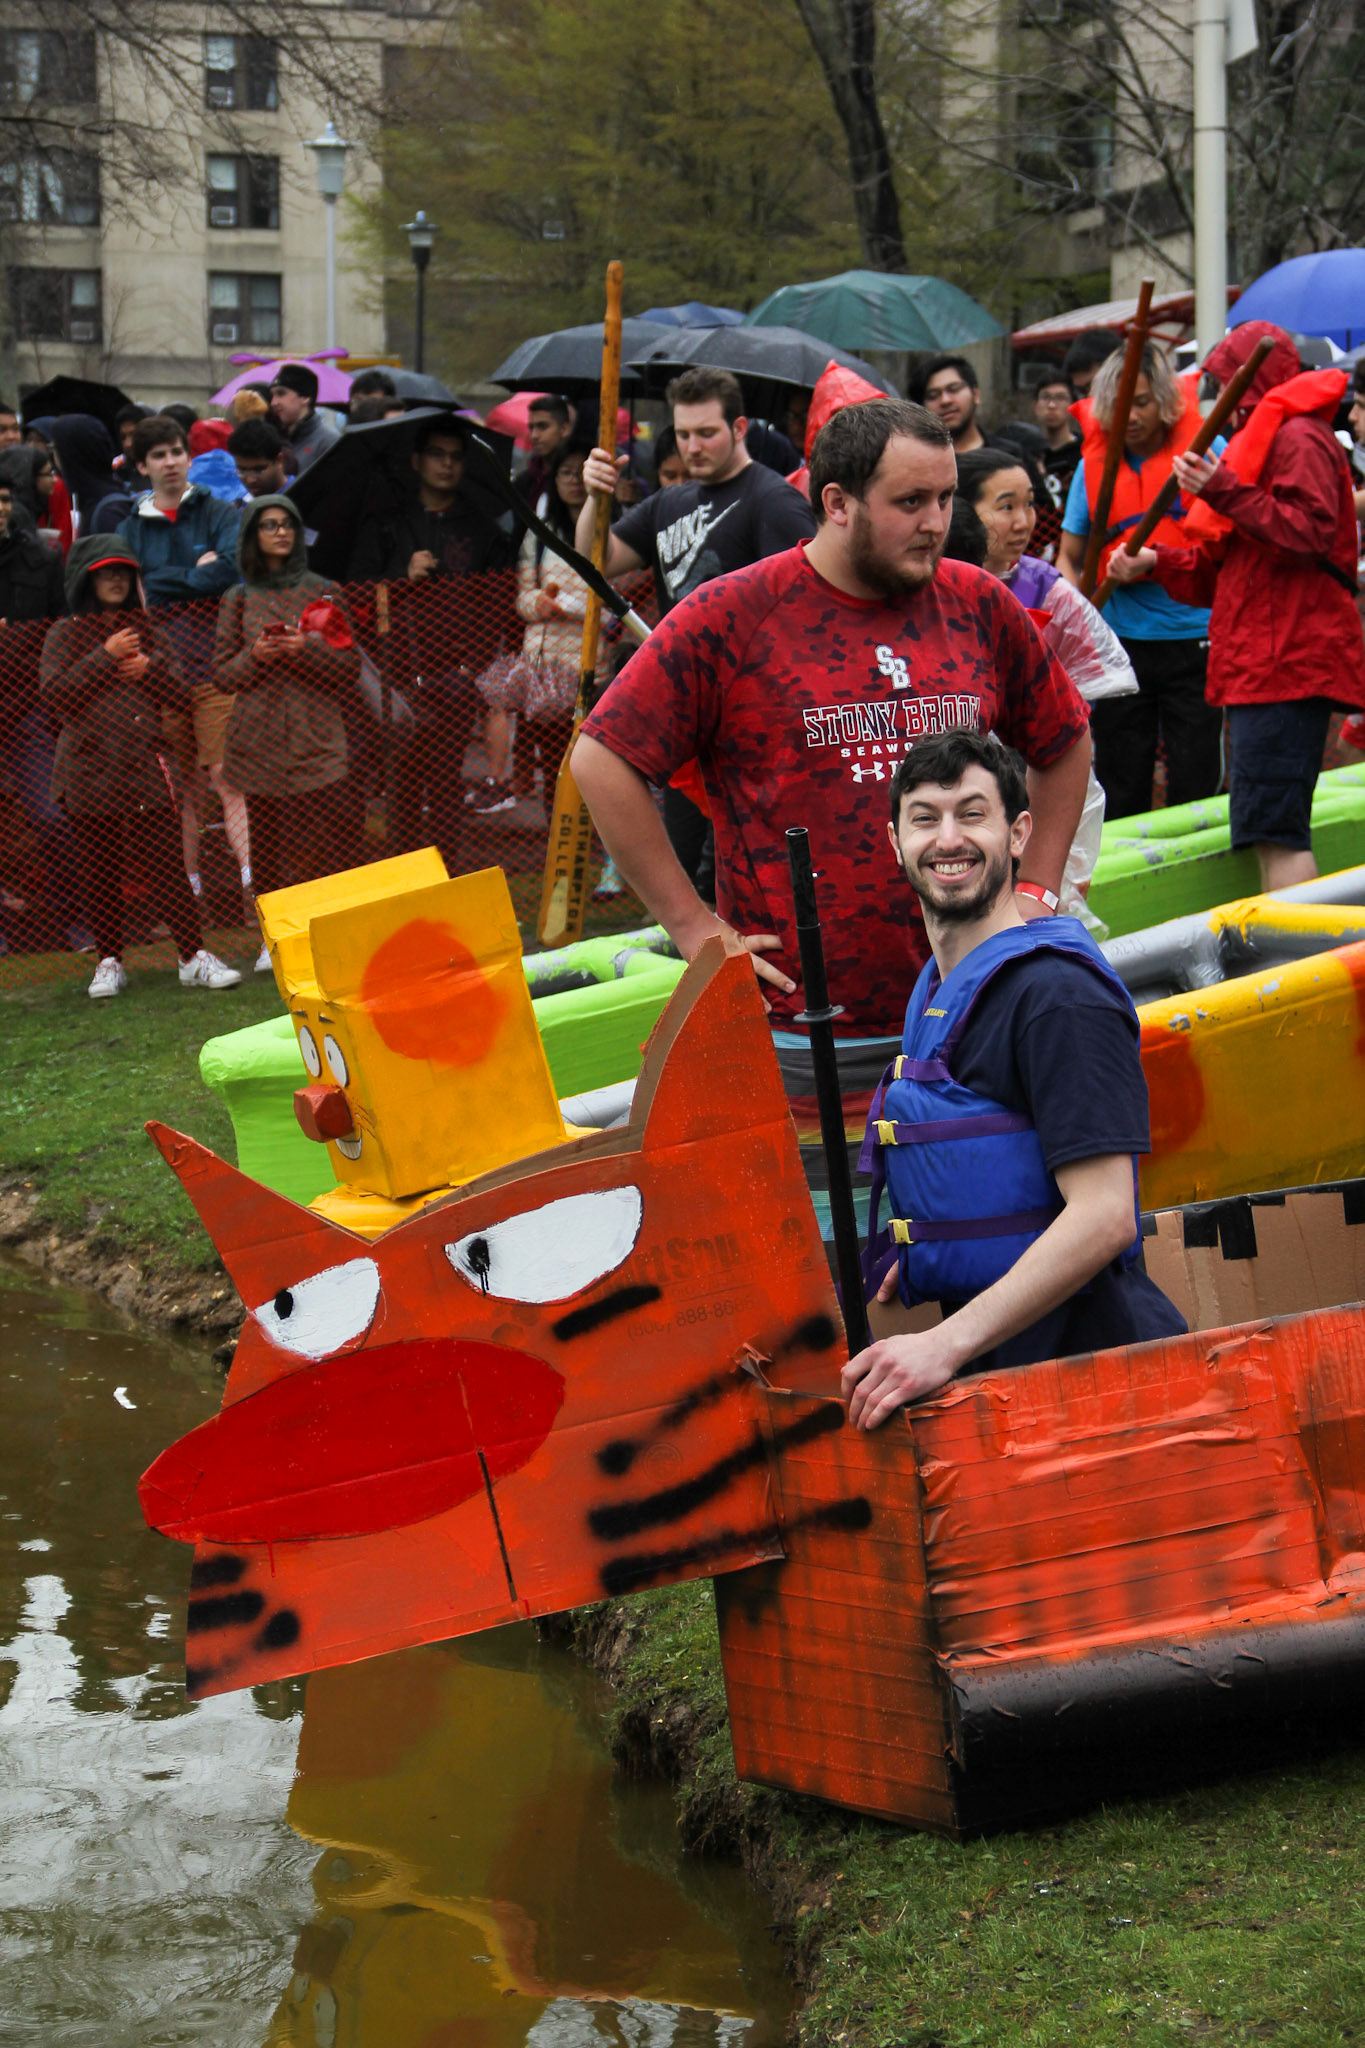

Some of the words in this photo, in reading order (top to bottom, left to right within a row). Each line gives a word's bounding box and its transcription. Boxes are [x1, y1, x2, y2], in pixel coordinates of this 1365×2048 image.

[656, 501, 713, 564] NIKE
[875, 644, 911, 690] SB
[803, 701, 898, 747] STONY
[902, 694, 980, 737] BROOK
[840, 741, 915, 758] SEAWO
[566, 802, 590, 933] OUTHAMPTON
